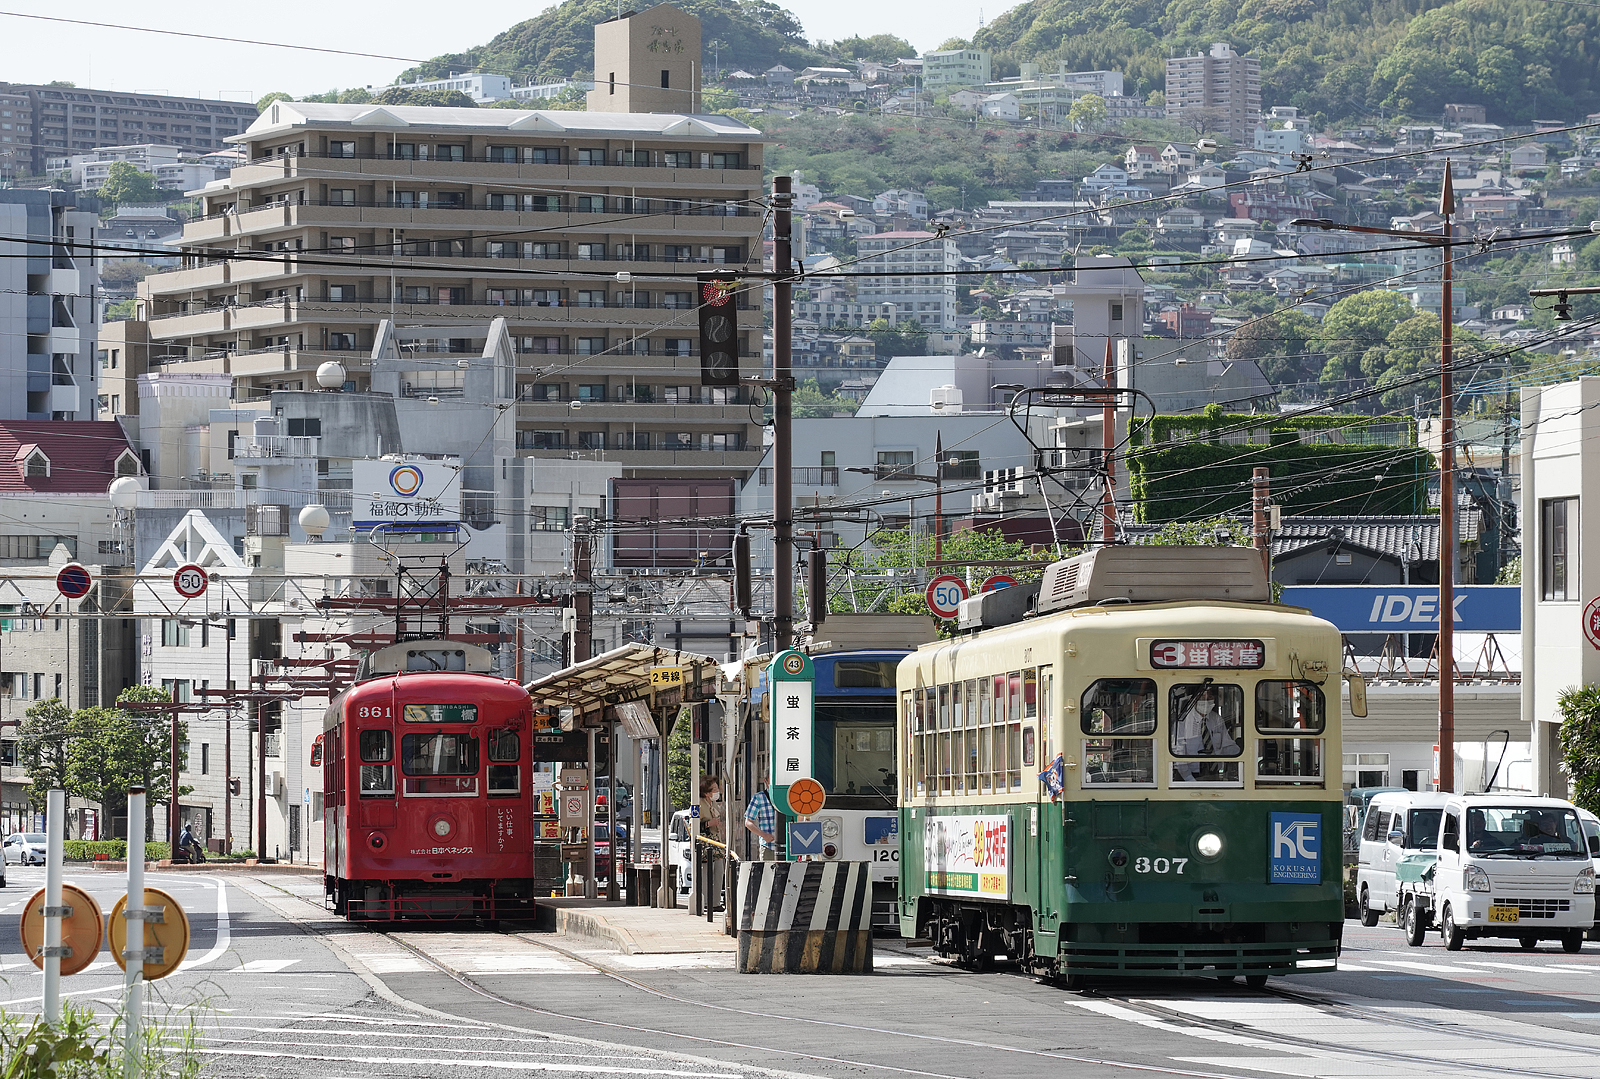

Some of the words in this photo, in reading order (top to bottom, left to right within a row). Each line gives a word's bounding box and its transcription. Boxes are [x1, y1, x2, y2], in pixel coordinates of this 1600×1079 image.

[369, 501, 443, 517] 福徳不動産
[181, 574, 200, 589] 50
[936, 587, 960, 606] 50
[1368, 595, 1468, 622] IDEX
[1152, 642, 1186, 666] 3
[1189, 648, 1259, 667] 蛍茶屋
[788, 660, 800, 669] 43
[652, 670, 680, 683] 2号線
[359, 706, 392, 718] 361
[786, 695, 800, 772] 蛍茶屋
[505, 808, 514, 839] いい仕事、
[1134, 856, 1189, 875] 307
[1273, 864, 1317, 872] KOKUSAI
[1273, 871, 1317, 879] ENGINEERING
